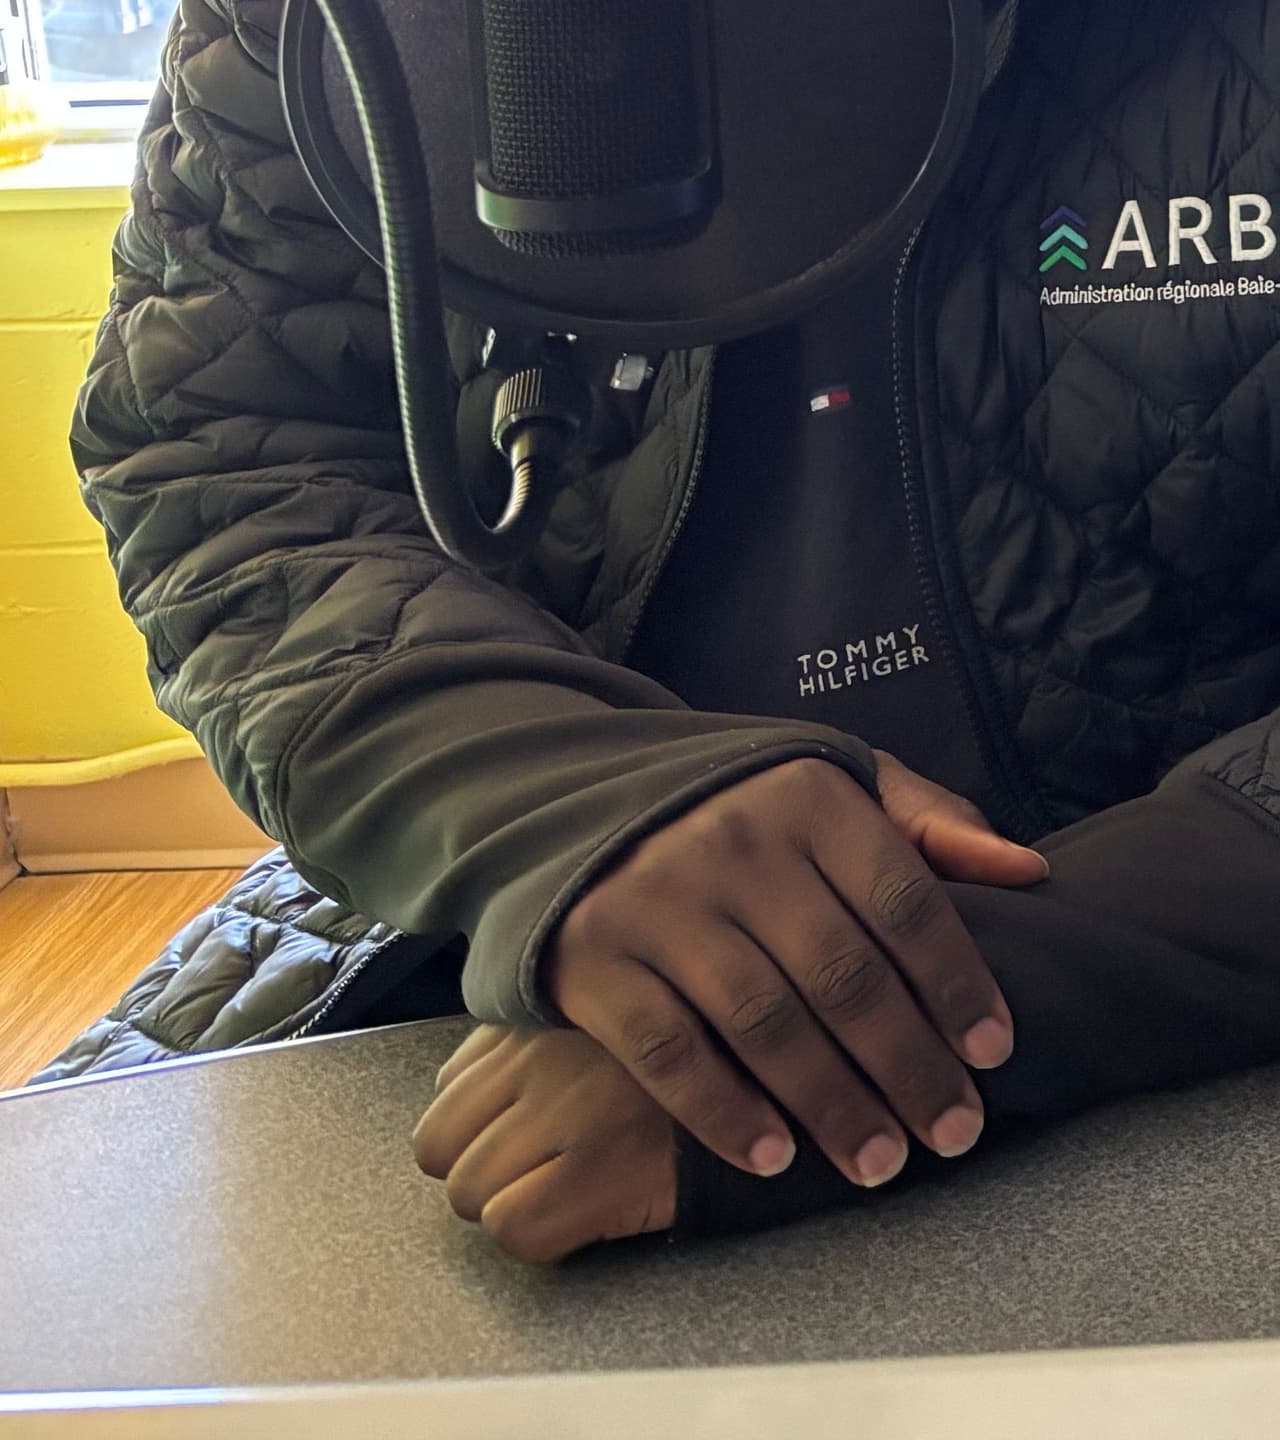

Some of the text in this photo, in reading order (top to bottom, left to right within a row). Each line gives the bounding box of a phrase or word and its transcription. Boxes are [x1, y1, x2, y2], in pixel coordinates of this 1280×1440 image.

[1040, 279, 1154, 306] Administration
[1157, 277, 1235, 304] régionale
[797, 623, 920, 674] TOMMY
[799, 645, 930, 697] HILFIGER
